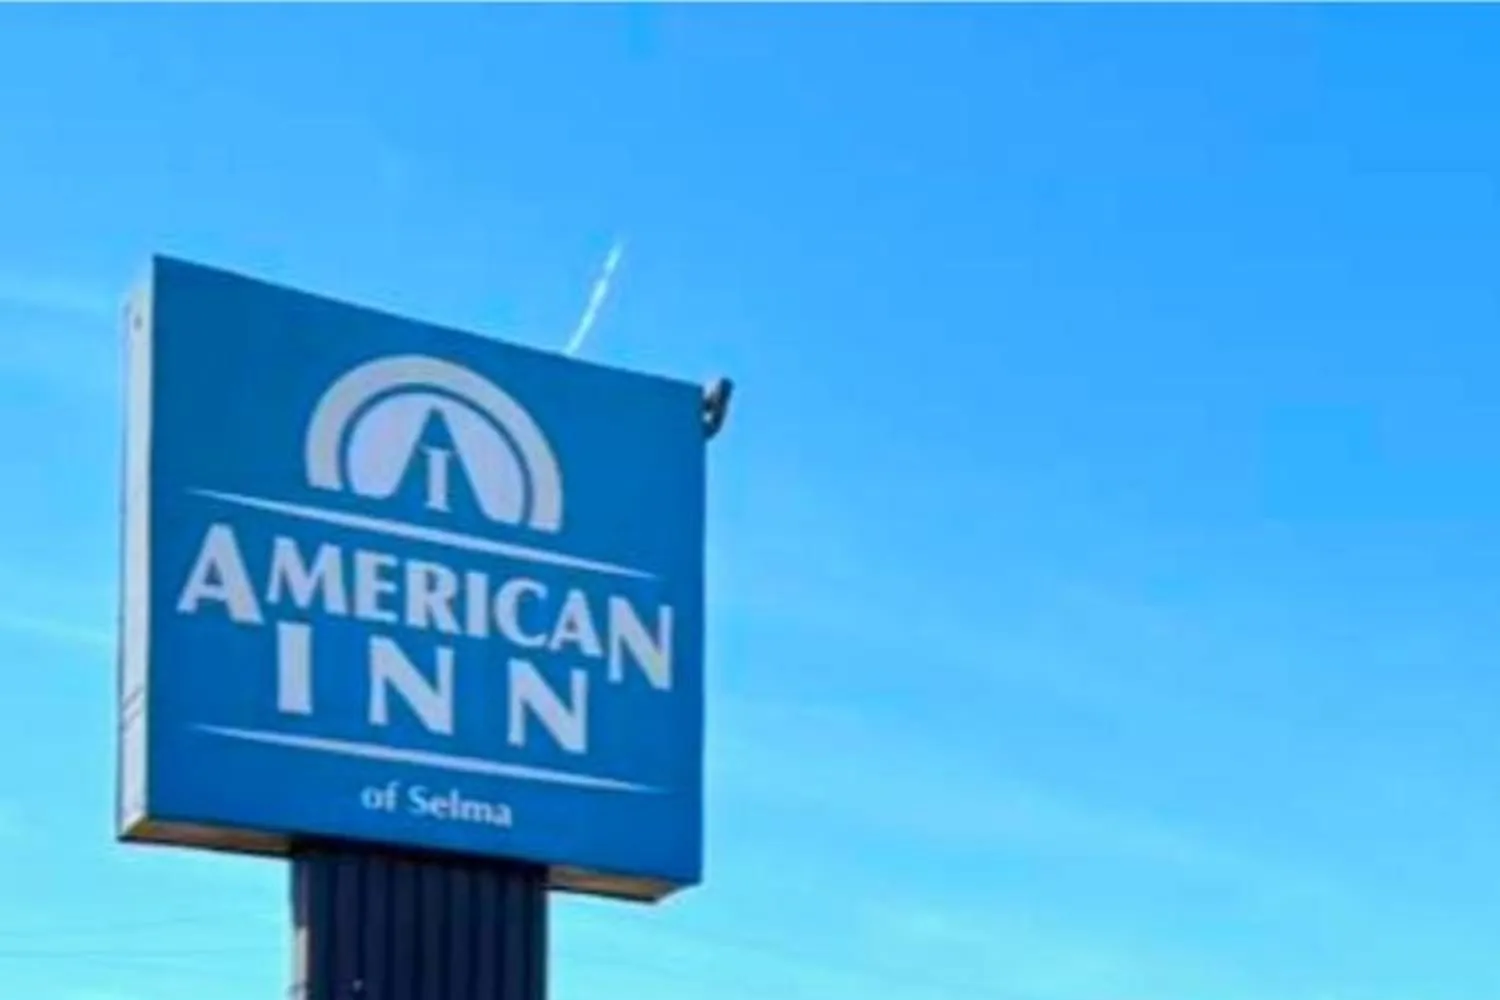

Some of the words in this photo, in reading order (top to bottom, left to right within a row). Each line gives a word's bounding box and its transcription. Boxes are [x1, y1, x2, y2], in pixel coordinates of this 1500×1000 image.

[177, 523, 673, 691] AMERICAN
[276, 620, 589, 755] INN
[360, 780, 400, 812] of
[407, 784, 514, 828] Selma
